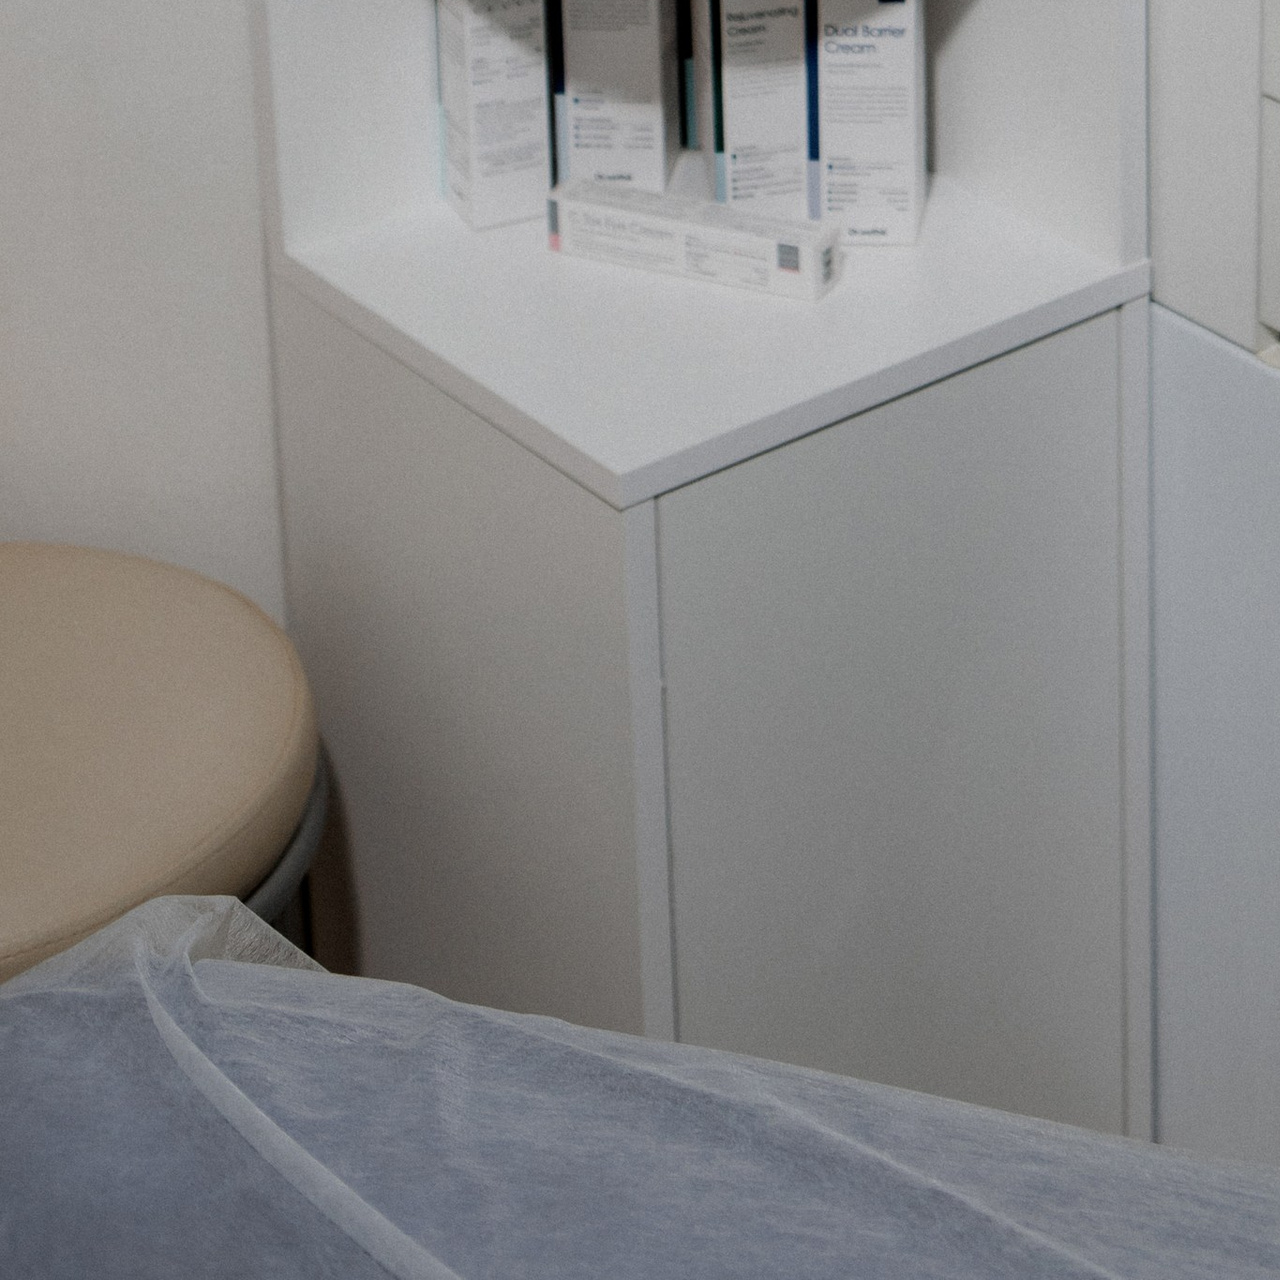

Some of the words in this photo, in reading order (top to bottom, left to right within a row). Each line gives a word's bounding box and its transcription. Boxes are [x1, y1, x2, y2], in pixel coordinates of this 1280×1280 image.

[727, 6, 799, 23] Rejuvenating
[727, 24, 766, 38] Cream
[824, 23, 856, 38] Dual
[860, 25, 906, 38] Barrier
[824, 40, 877, 54] Cream
